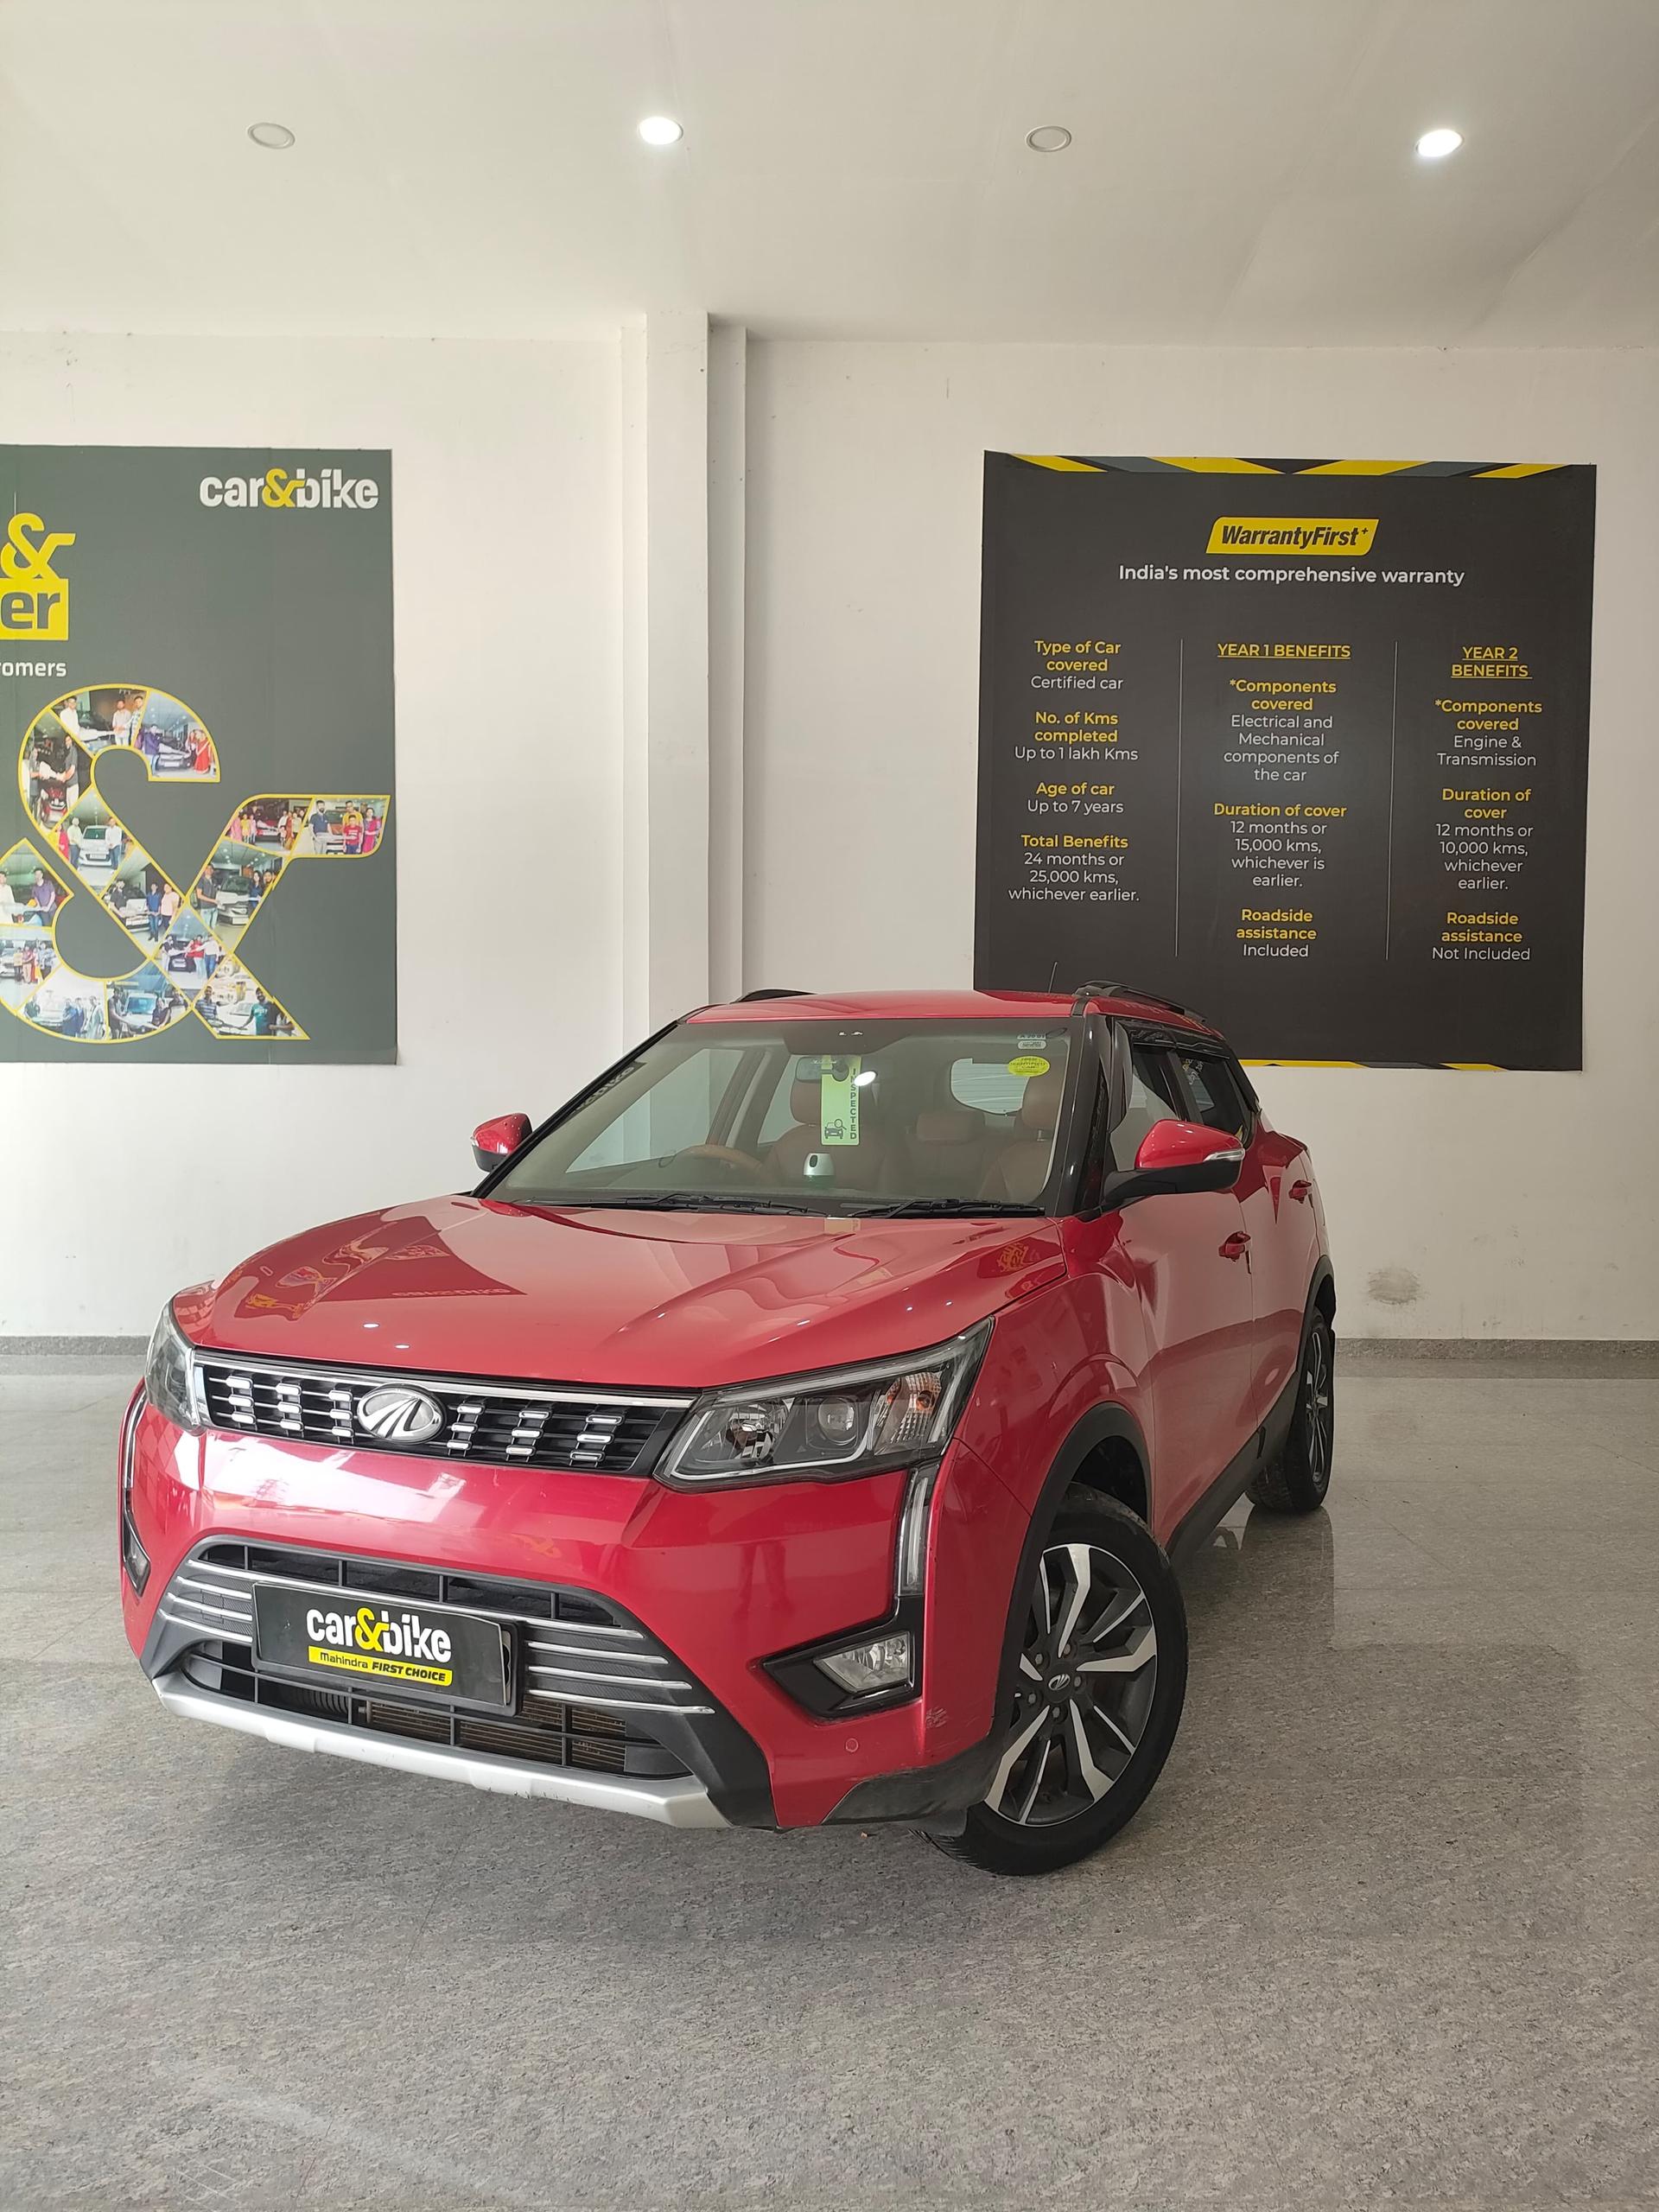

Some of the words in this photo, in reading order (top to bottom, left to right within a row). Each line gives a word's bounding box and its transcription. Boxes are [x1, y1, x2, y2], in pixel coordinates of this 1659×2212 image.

[200, 467, 379, 510] car&bike
[1119, 563, 1179, 581] India's
[1183, 567, 1230, 581] most
[1235, 566, 1377, 585] comprehensive
[1381, 569, 1465, 587] warranty
[1033, 640, 1071, 656] Type
[1075, 640, 1092, 653] of
[1094, 641, 1122, 654] Car
[1217, 643, 1260, 658] YEAR
[1263, 644, 1269, 657] 1
[1274, 644, 1351, 658] BENEFITS
[1462, 646, 1505, 660] YEAR
[1509, 647, 1518, 659] 2
[0, 661, 67, 677] omers
[1046, 658, 1108, 671] covered
[1452, 664, 1529, 677] BENEFITS
[1031, 676, 1096, 690] Certified
[1099, 679, 1124, 690] car
[1251, 697, 1313, 710] covered
[1035, 711, 1060, 724] No.
[1064, 711, 1081, 724] of
[1084, 712, 1118, 725] Kms
[1231, 714, 1300, 728] Electrical
[1303, 715, 1333, 728] and
[1457, 717, 1519, 731] covered
[1034, 728, 1118, 745] completed
[1239, 732, 1325, 747] Mechanical
[1454, 734, 1508, 751] Engine
[1511, 735, 1522, 748] &
[1014, 746, 1037, 762] Up
[1039, 747, 1056, 760] to
[1058, 747, 1064, 760] 1
[1069, 747, 1100, 760] lakh
[1104, 747, 1139, 760] Kms
[1224, 752, 1320, 766] components
[1323, 751, 1340, 764] of
[1436, 753, 1536, 766] Transmission
[1254, 767, 1280, 781] the
[1283, 771, 1307, 781] car
[1035, 782, 1067, 798] Age
[1071, 782, 1088, 795] of
[1090, 785, 1116, 796] car
[1442, 787, 1510, 801] Duration
[1515, 788, 1532, 802] of
[1027, 799, 1049, 815] Up
[1052, 801, 1068, 812] to
[1071, 799, 1081, 813] 7
[1084, 803, 1124, 816] years
[1214, 803, 1281, 817] Duration
[1284, 804, 1301, 817] of
[1304, 807, 1347, 817] cover
[1464, 808, 1508, 819] cover
[1230, 820, 1245, 834] 12
[1249, 821, 1308, 835] months
[1311, 824, 1327, 835] or
[1435, 823, 1451, 836] 12
[1454, 823, 1515, 837] months
[1517, 827, 1534, 837] or
[1020, 835, 1058, 848] Total
[1063, 835, 1128, 849] Benefits
[1235, 838, 1282, 853] 15,000
[1286, 838, 1321, 854] kms,
[1440, 841, 1489, 856] 10,000
[1493, 841, 1529, 856] kms,
[1024, 852, 1043, 865] 24
[1046, 852, 1106, 866] months
[1109, 855, 1125, 866] or
[1231, 855, 1310, 869] whichever
[1313, 856, 1325, 870] is
[1444, 858, 1523, 872] whichever
[1029, 869, 1080, 885] 25,000
[1084, 869, 1119, 886] kms,
[1252, 874, 1303, 887] earlier.
[1458, 876, 1509, 890] earlier.
[1007, 887, 1086, 900] whichever
[1090, 887, 1140, 901] earlier.
[1242, 908, 1313, 922] Roadside
[1446, 911, 1519, 925] Roadside
[1236, 925, 1317, 940] assistance
[1441, 928, 1522, 943] assistance
[1243, 944, 1309, 957] Included
[1432, 946, 1459, 960] Not
[1464, 947, 1530, 961] Included
[306, 1607, 452, 1663] car&bike
[320, 1651, 368, 1669] Mahindra
[372, 1662, 404, 1675] FIRST
[404, 1667, 446, 1681] CHOICE
